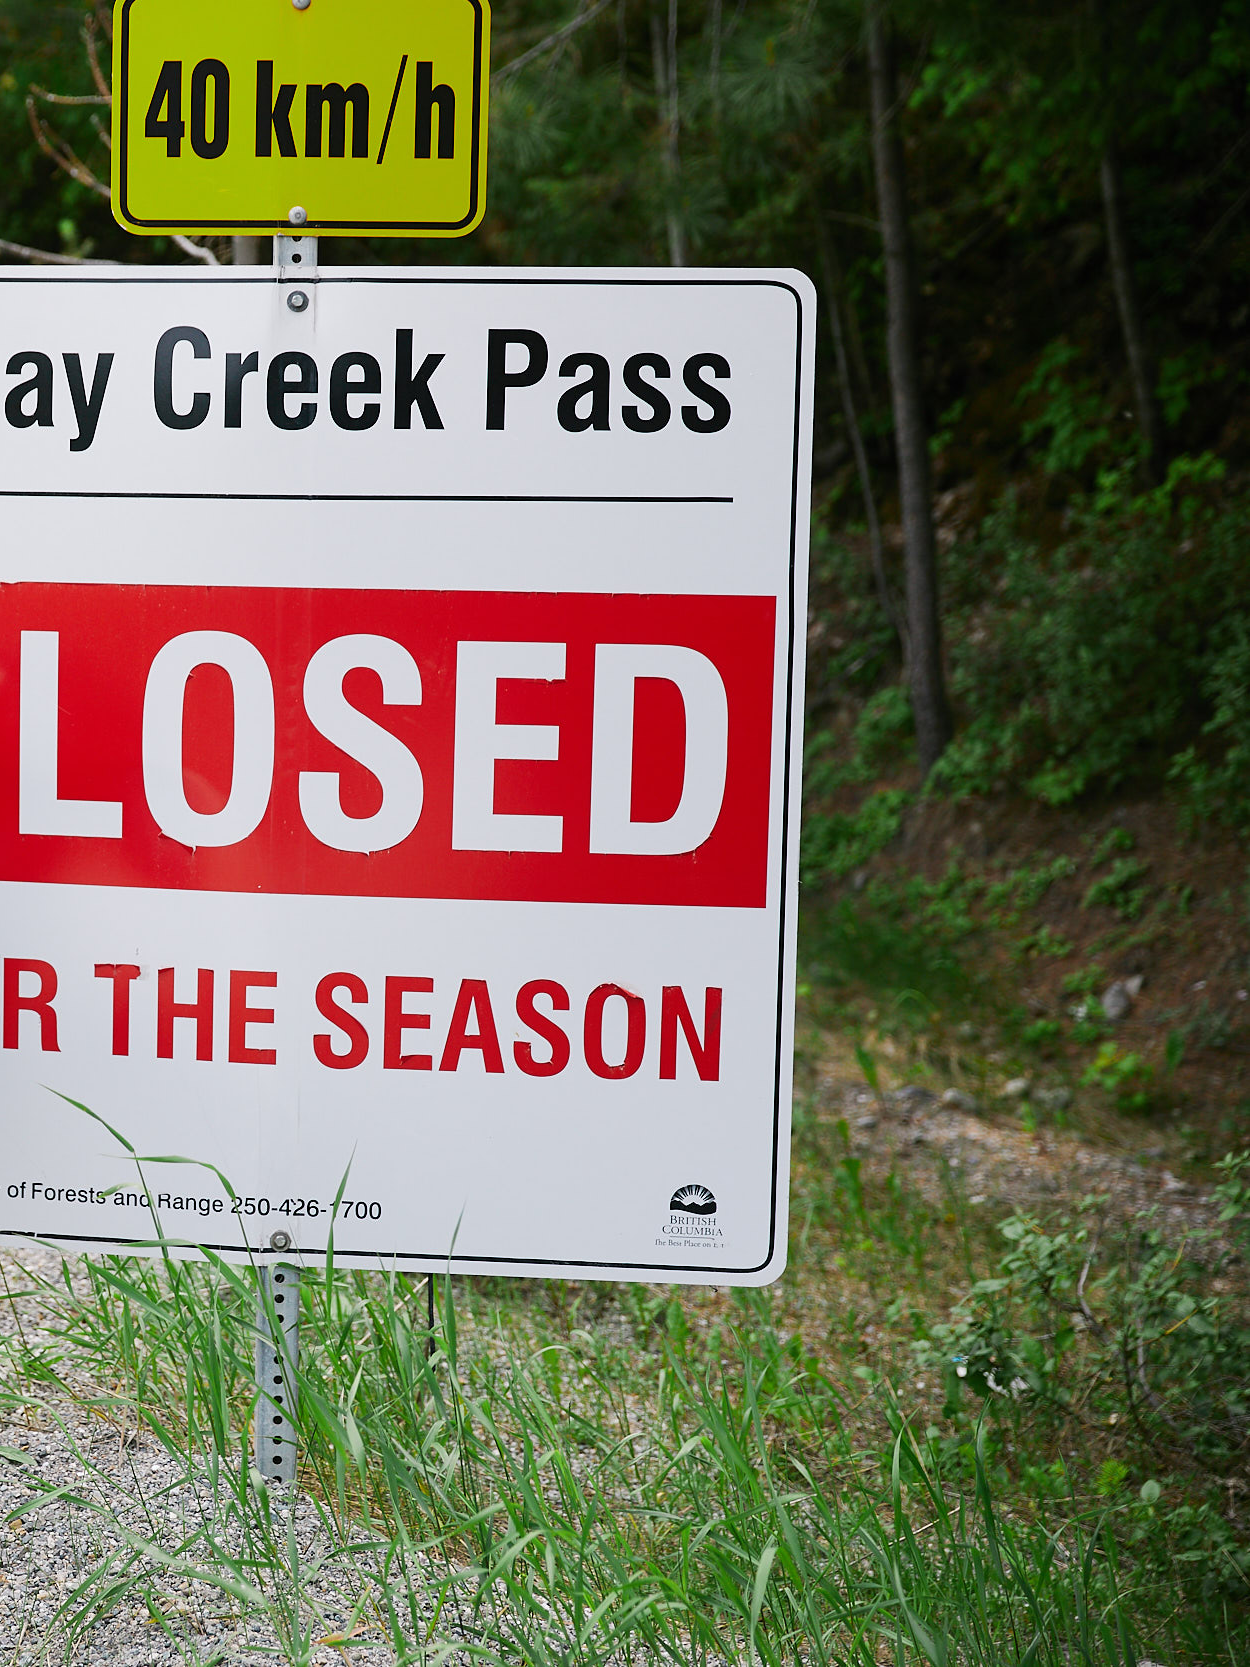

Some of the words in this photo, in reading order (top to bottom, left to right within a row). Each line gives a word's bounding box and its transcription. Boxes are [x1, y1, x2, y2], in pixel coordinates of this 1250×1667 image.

[145, 59, 231, 160] 40
[254, 55, 456, 165] km/h
[154, 326, 446, 431] Creek
[486, 329, 732, 434] Pass
[94, 964, 278, 1066] THE
[312, 972, 723, 1082] SEASON
[7, 1181, 26, 1199] of
[31, 1182, 106, 1205] Forests
[158, 1193, 224, 1216] Range
[662, 1225, 723, 1237] COLUMBIA
[670, 1214, 716, 1226] BRITISH
[655, 1238, 666, 1247] The
[668, 1239, 682, 1247] Best
[684, 1239, 701, 1248] Place
